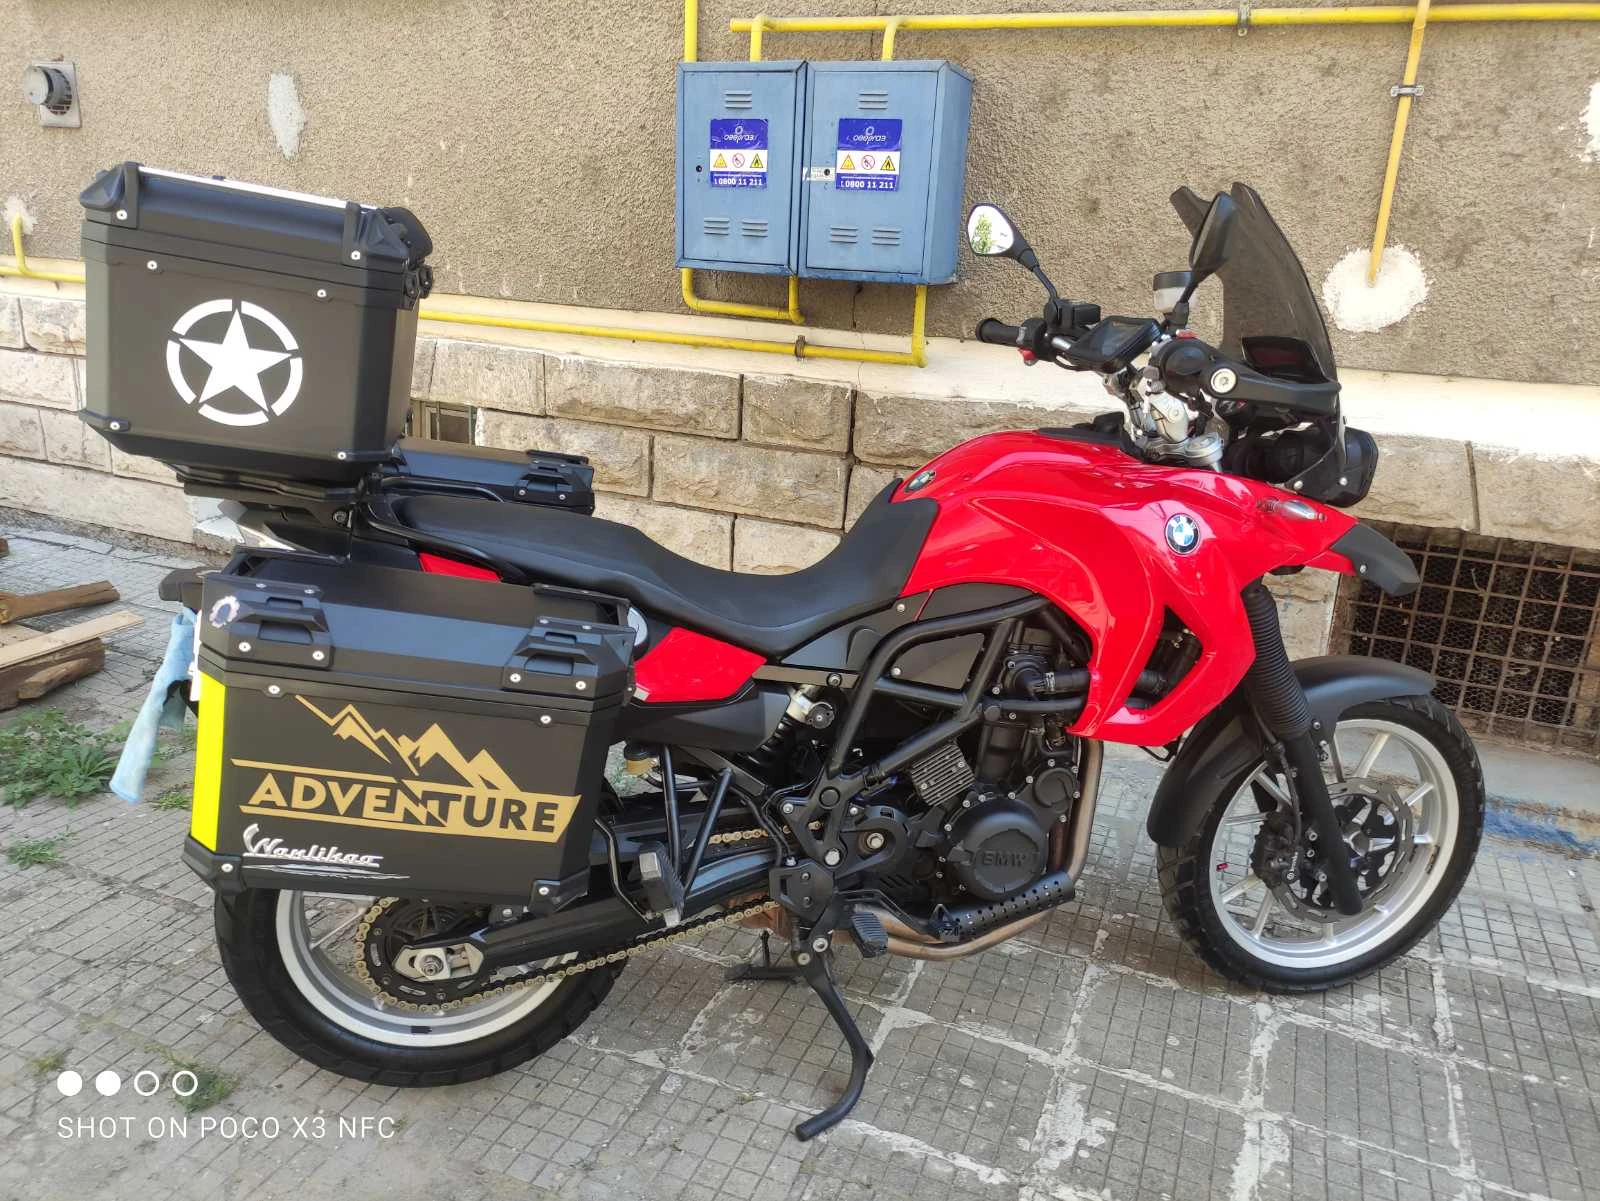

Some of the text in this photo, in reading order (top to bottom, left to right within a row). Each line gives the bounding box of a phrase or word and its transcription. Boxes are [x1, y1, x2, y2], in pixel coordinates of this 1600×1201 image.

[718, 177, 763, 186] 0800 11 211
[845, 180, 894, 189] 0800 11 211
[247, 772, 558, 833] ADVENTURE
[983, 849, 1026, 868] BMW
